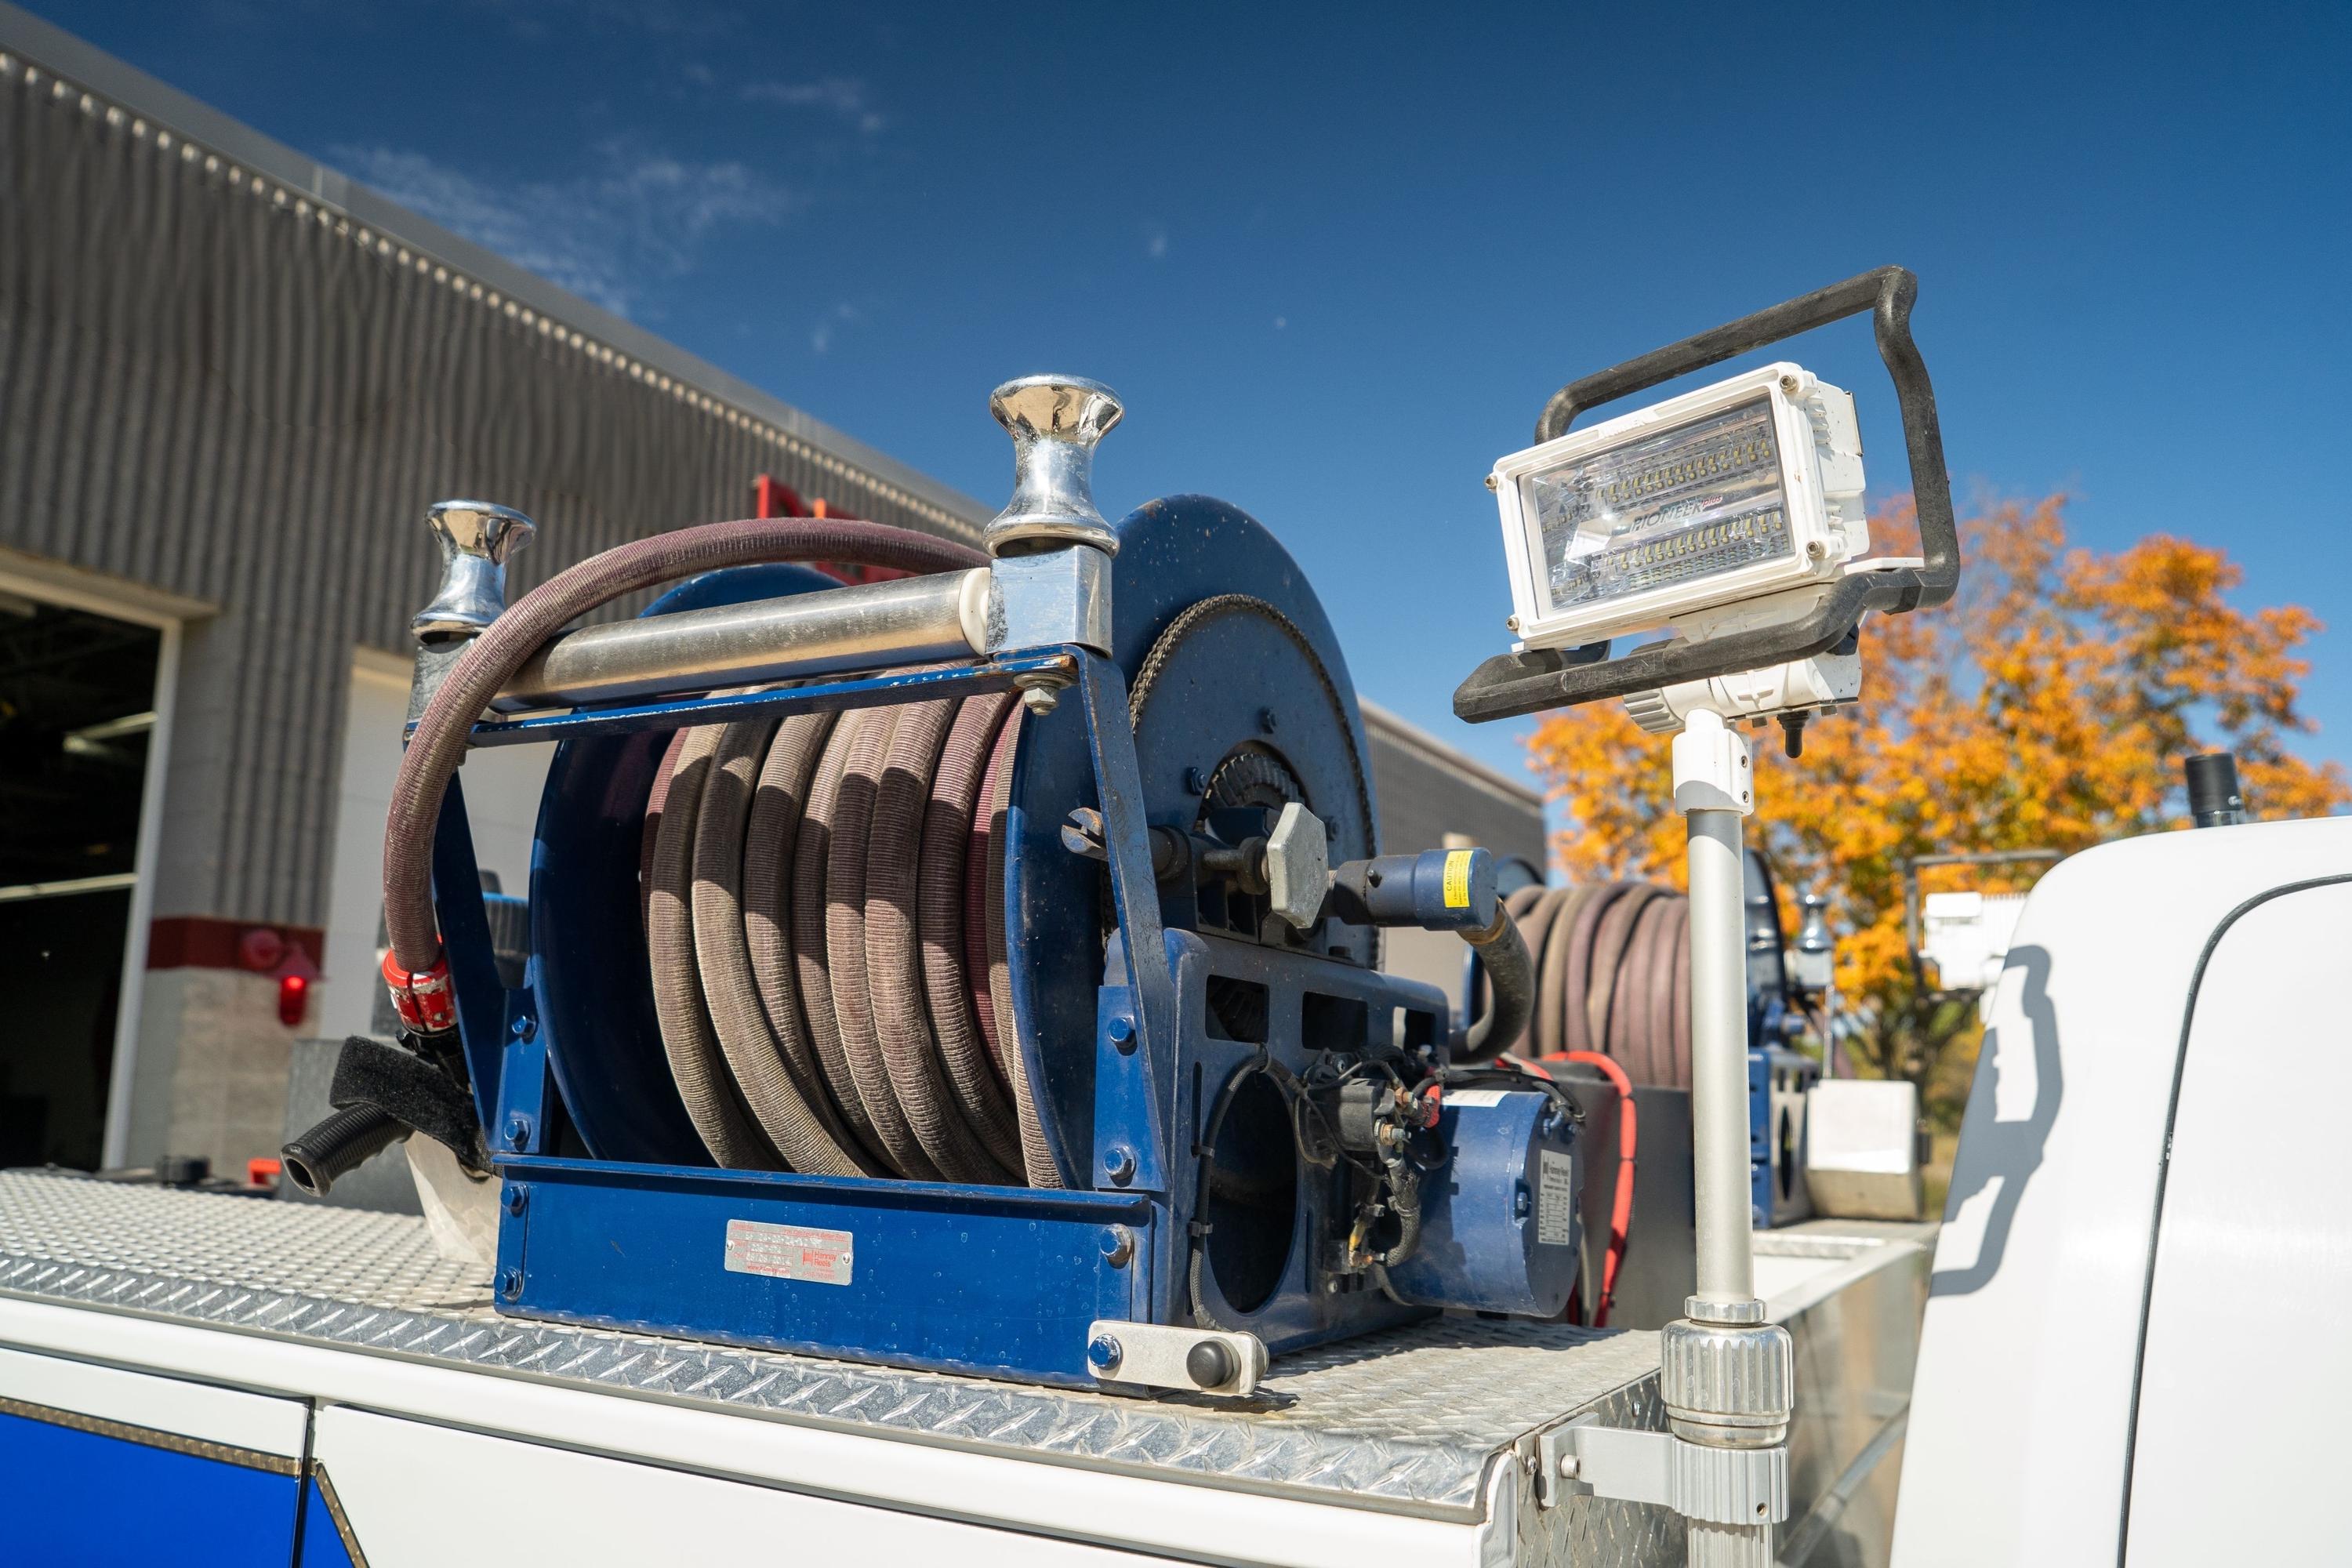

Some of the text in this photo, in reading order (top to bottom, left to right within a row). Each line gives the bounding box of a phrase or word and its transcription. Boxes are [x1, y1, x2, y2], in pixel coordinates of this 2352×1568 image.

[1631, 495, 1723, 532] PIONEER plus
[815, 1250, 837, 1263] Hannay
[815, 1259, 832, 1268] Reels
